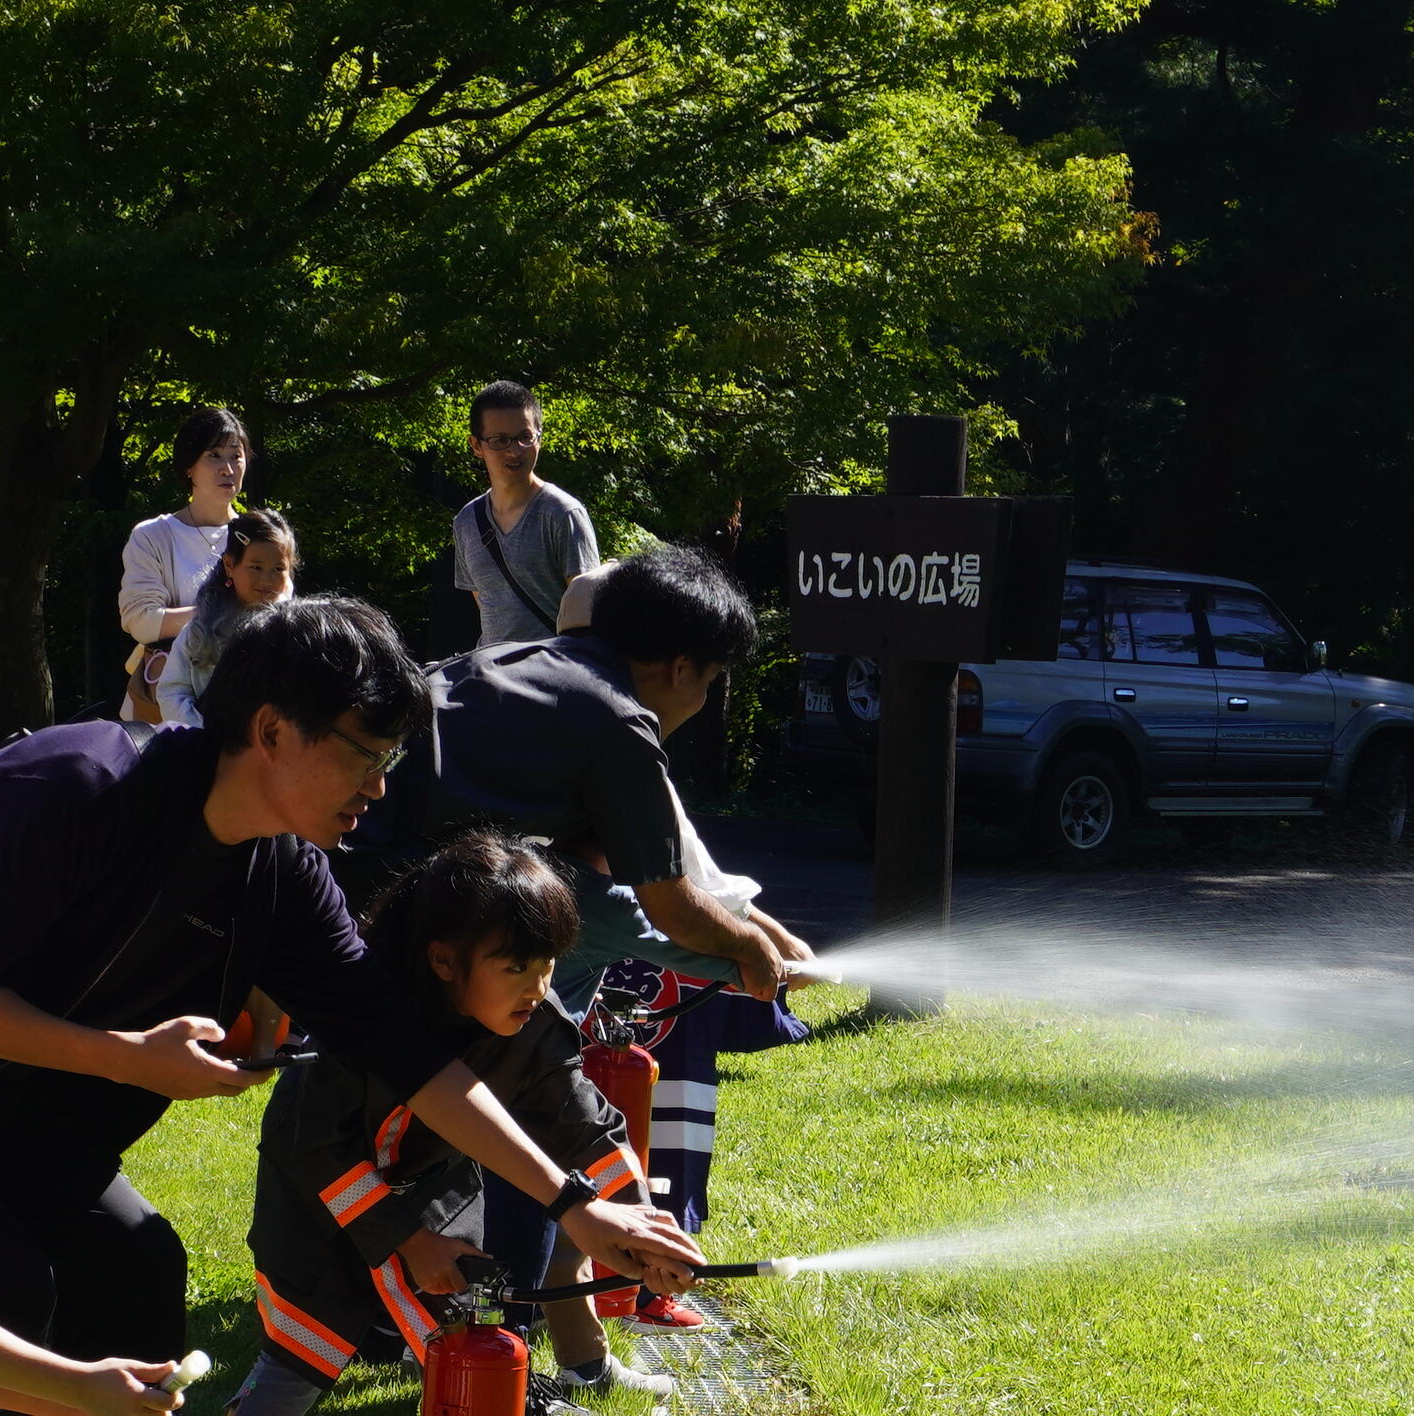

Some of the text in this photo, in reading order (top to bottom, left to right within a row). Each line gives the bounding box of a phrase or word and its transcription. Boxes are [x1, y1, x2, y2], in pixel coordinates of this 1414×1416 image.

[797, 549, 982, 608] いこいの広場
[179, 912, 226, 938] HEAD
